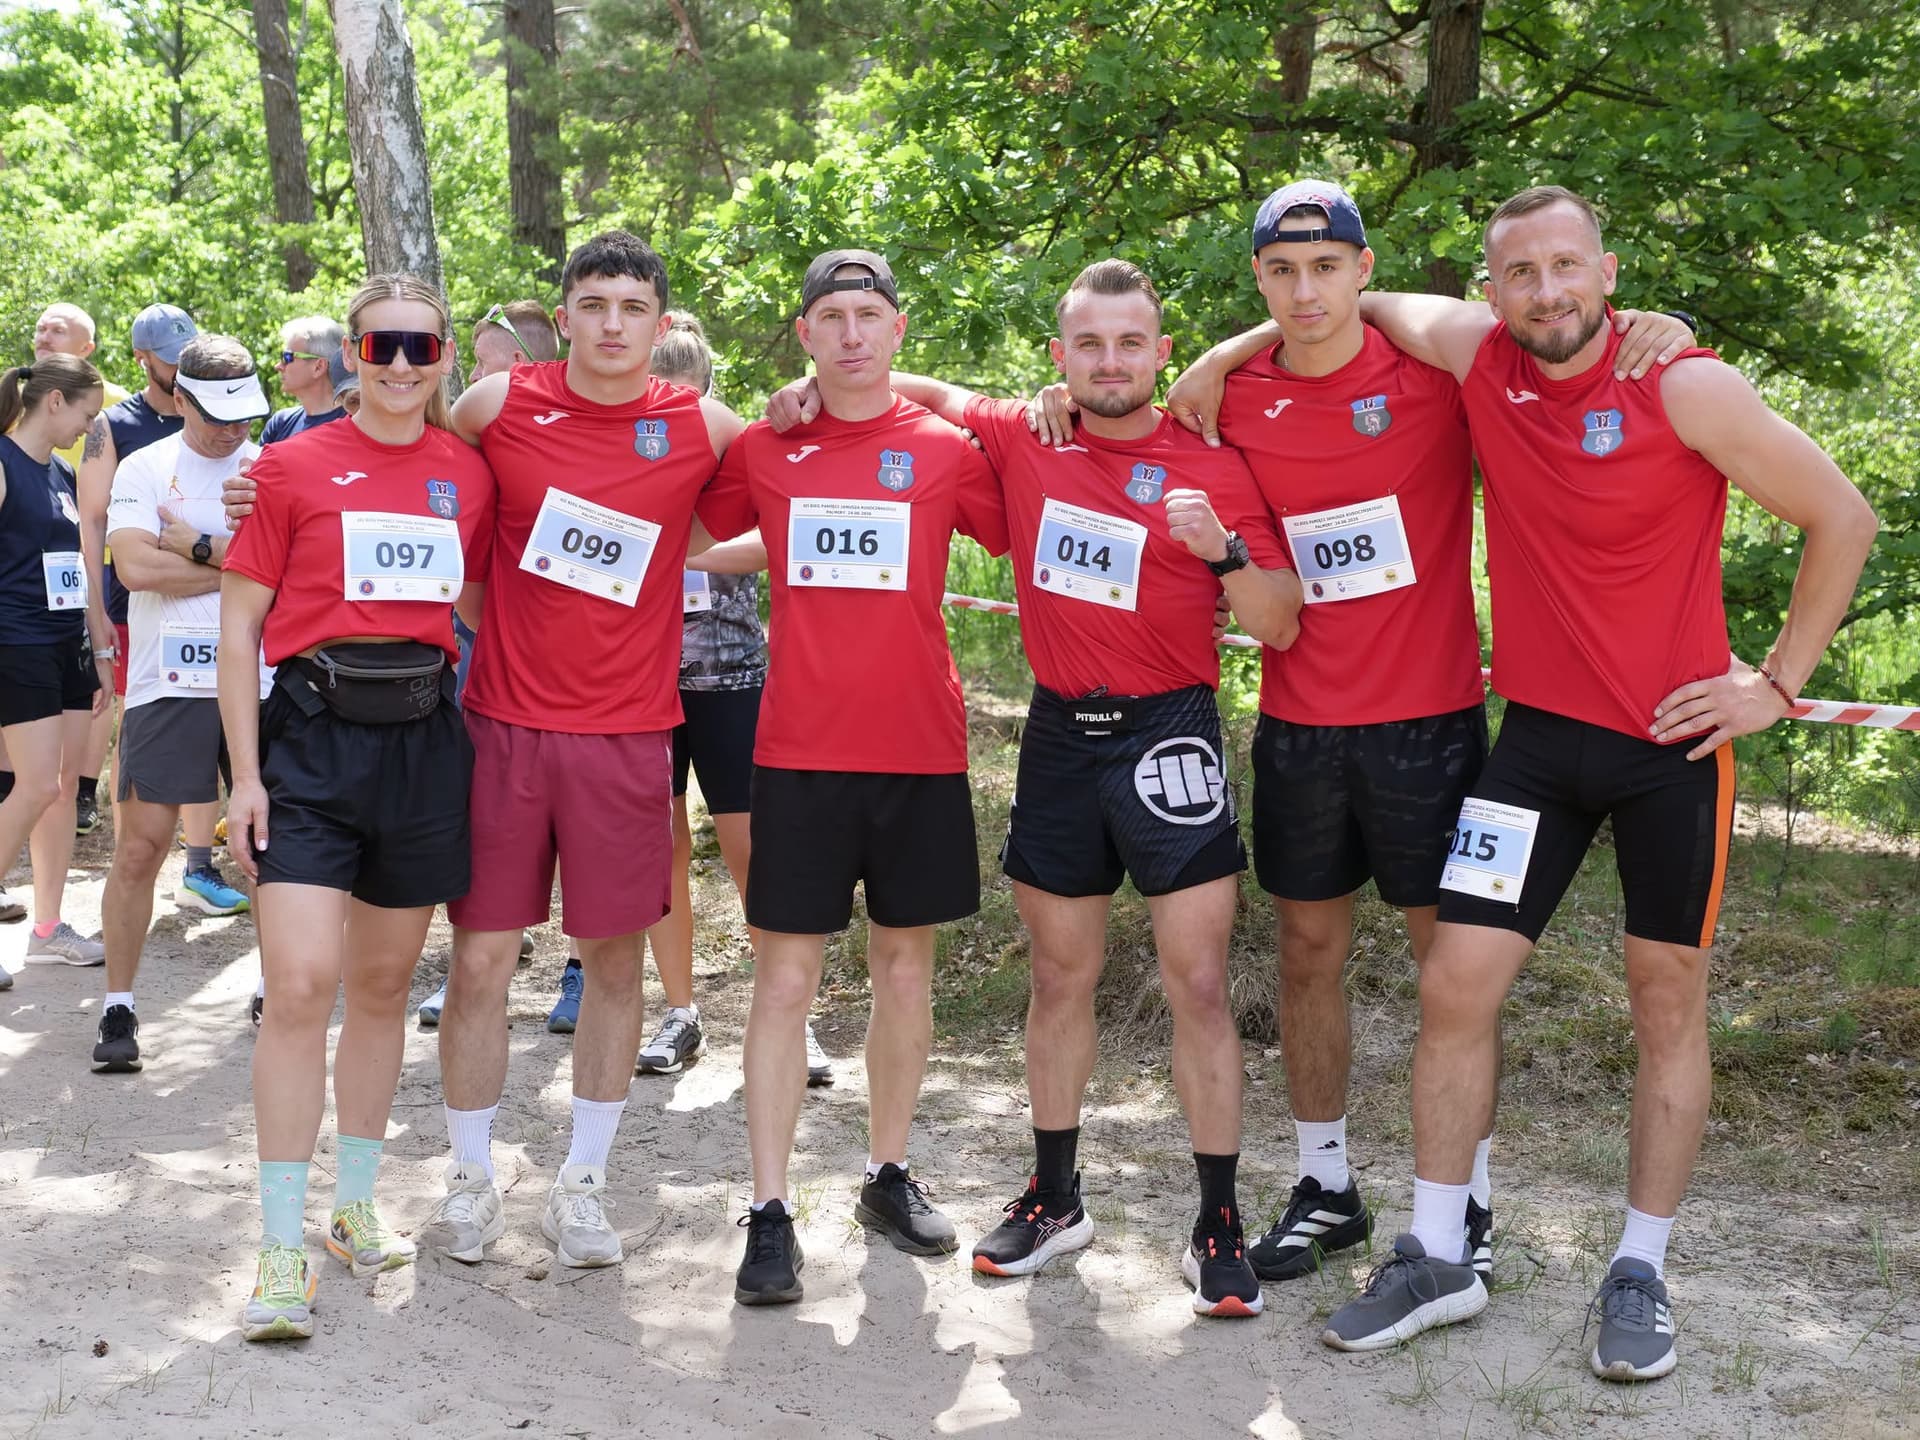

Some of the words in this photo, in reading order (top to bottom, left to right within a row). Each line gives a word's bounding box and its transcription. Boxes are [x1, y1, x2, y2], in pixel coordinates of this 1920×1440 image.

[375, 541, 435, 569] 097
[561, 527, 622, 566] 099
[816, 527, 879, 556] 016
[1057, 534, 1112, 572] 014
[1314, 534, 1376, 570] 098
[180, 643, 218, 665] 05
[1075, 712, 1112, 722] PITBULL
[1449, 828, 1499, 862] 015
